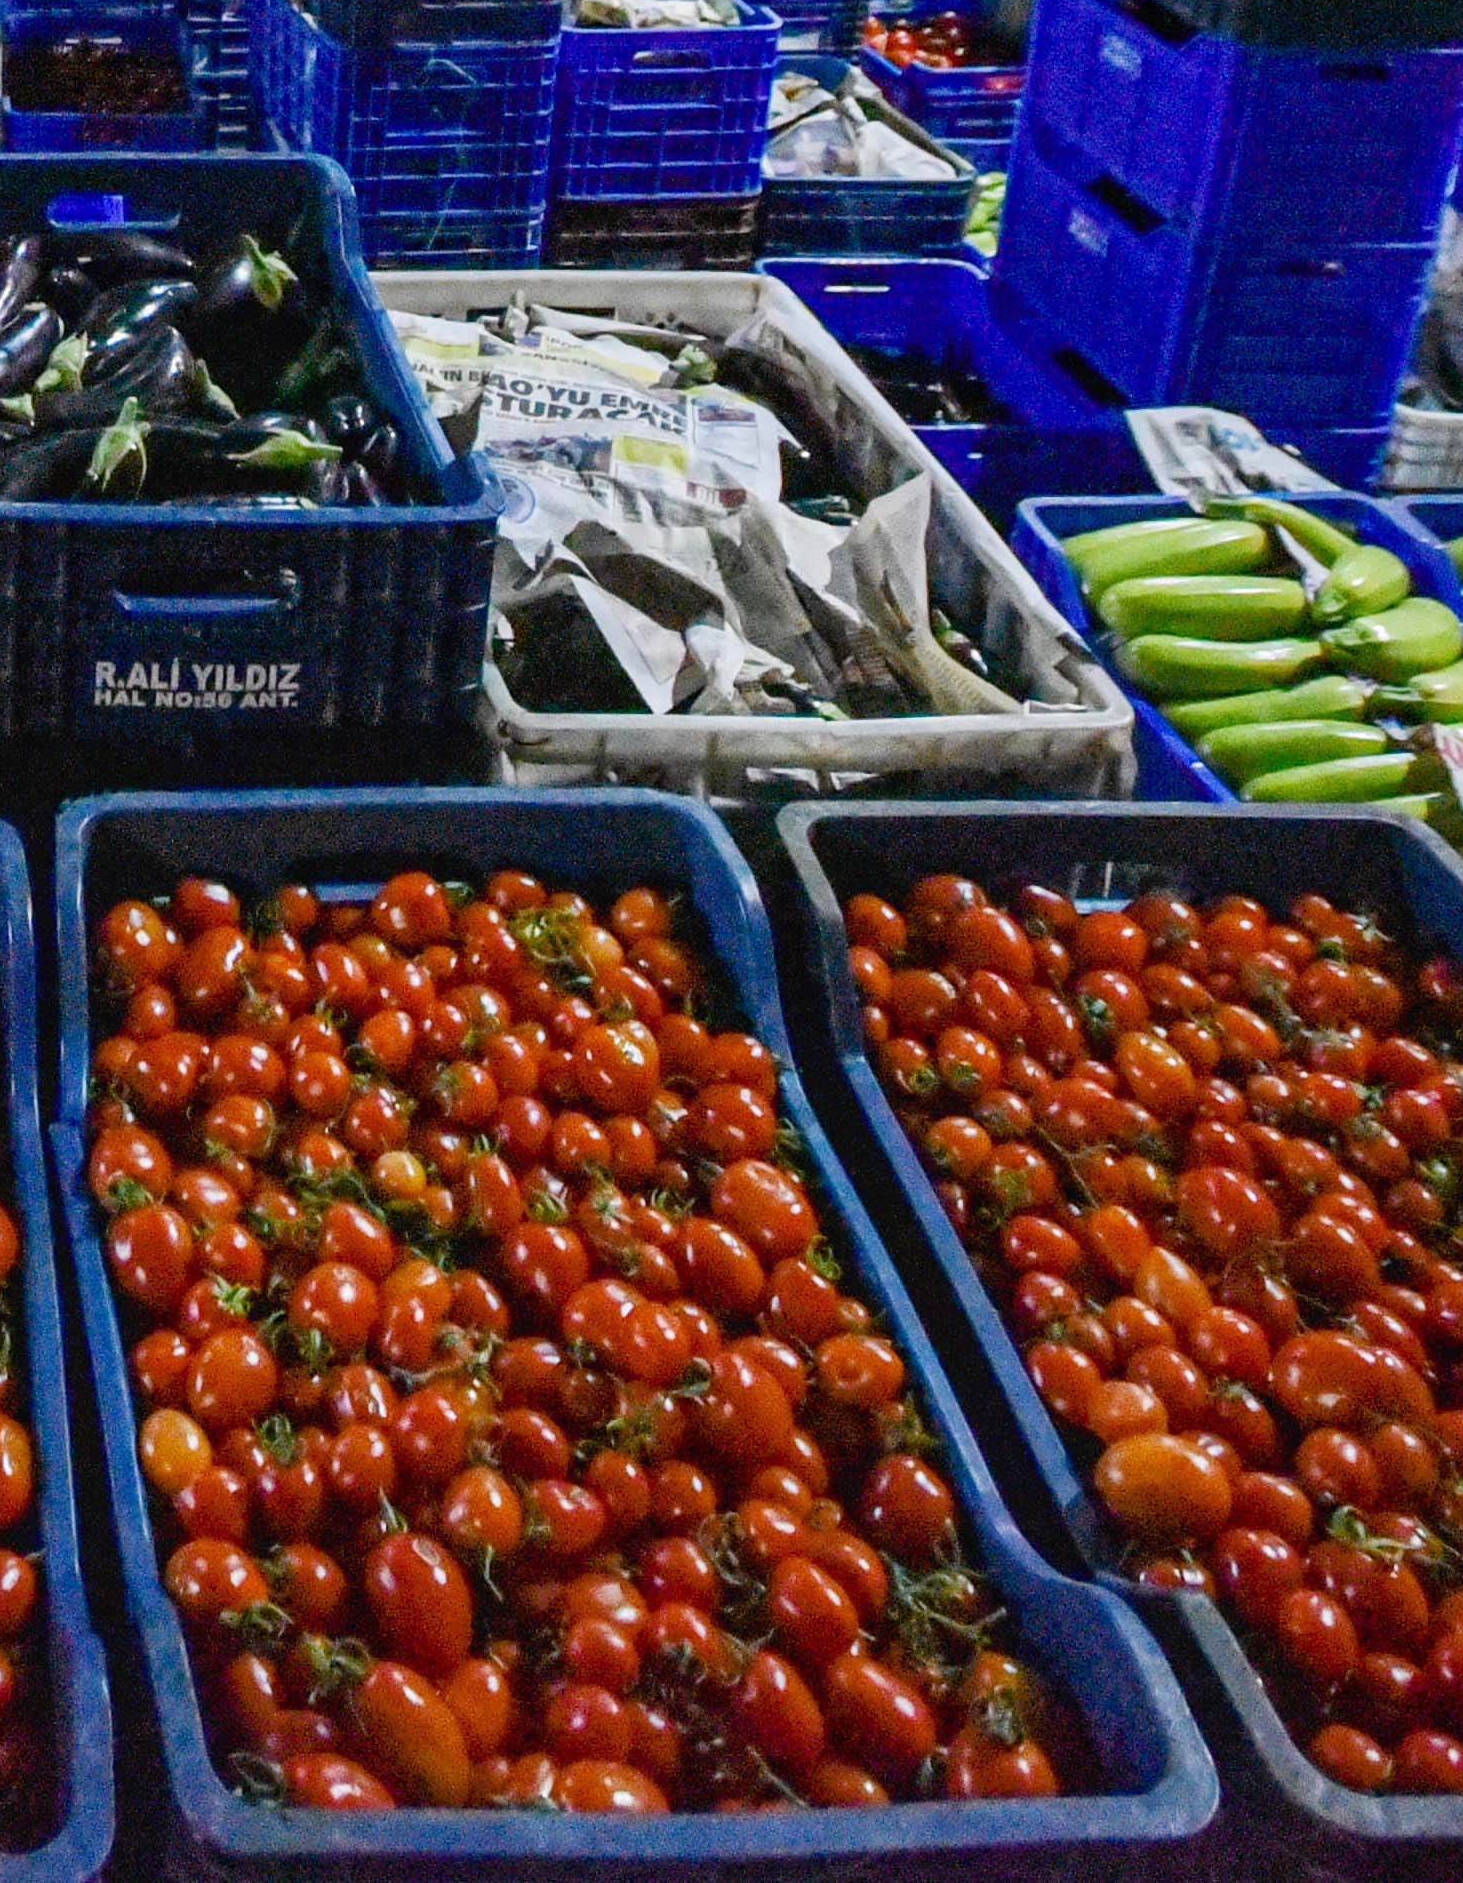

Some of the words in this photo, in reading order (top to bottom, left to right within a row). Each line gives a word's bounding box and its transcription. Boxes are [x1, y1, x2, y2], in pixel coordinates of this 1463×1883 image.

[95, 657, 180, 690] R.ALİ
[192, 664, 301, 692] YILDIZ
[94, 689, 146, 706] HAL
[239, 691, 299, 709] ANT.
